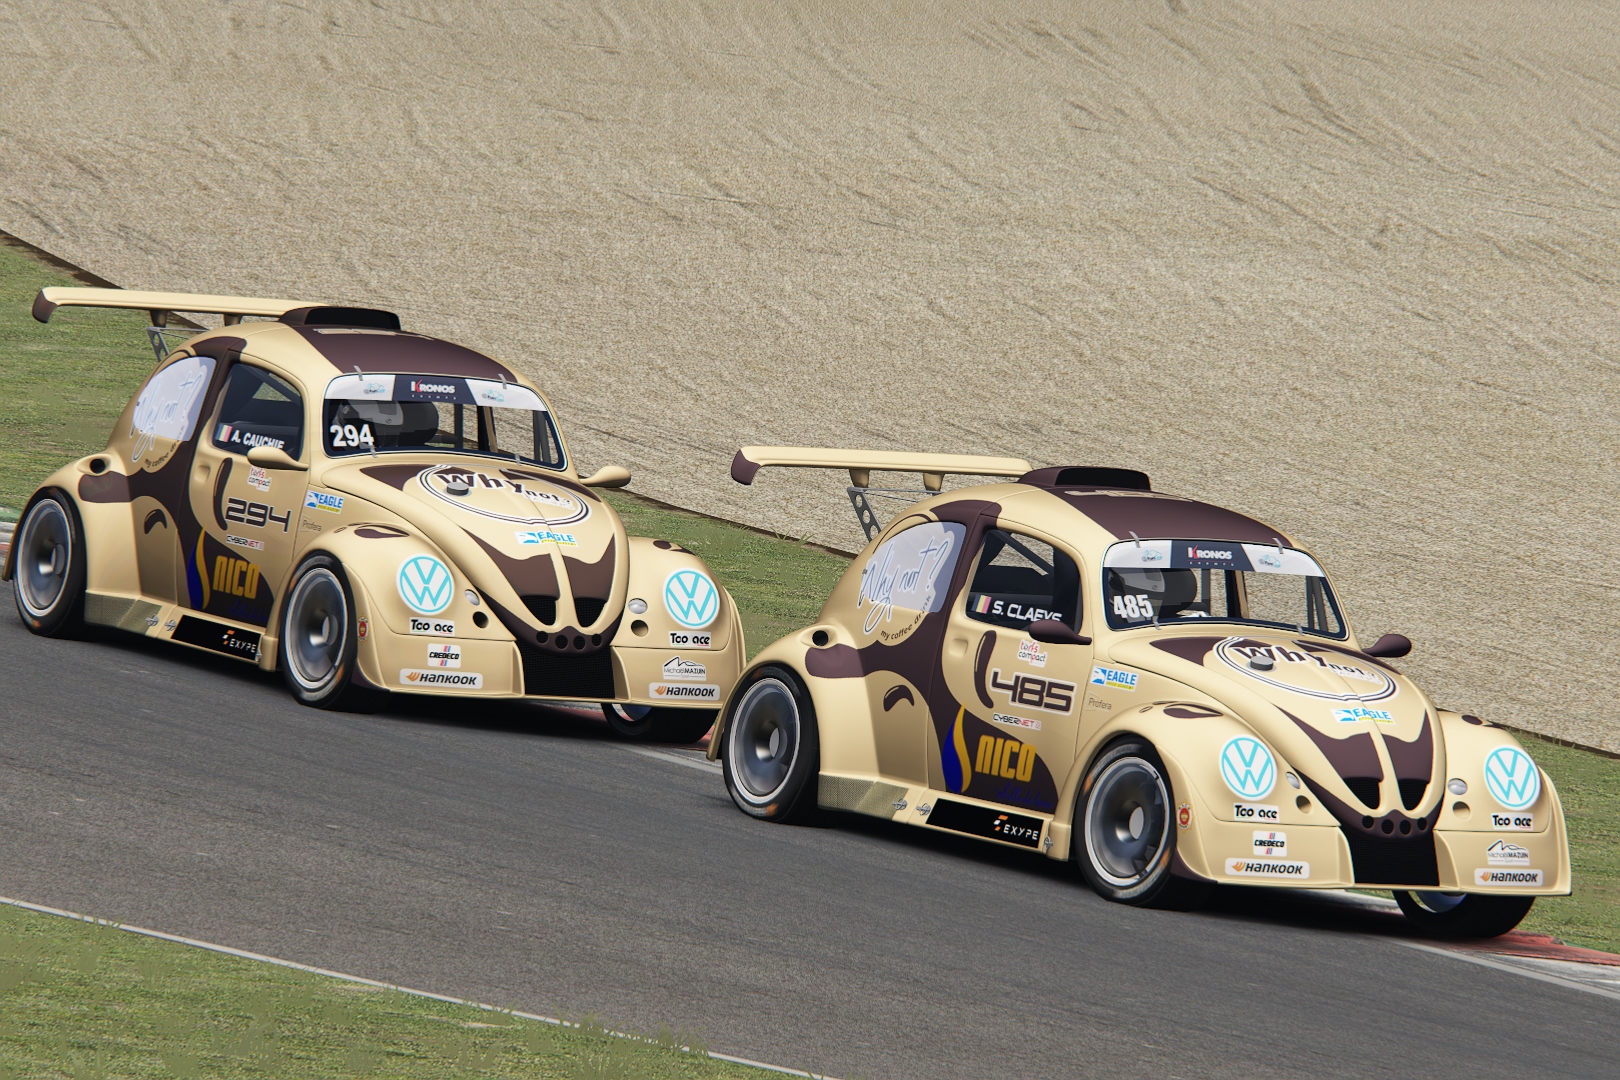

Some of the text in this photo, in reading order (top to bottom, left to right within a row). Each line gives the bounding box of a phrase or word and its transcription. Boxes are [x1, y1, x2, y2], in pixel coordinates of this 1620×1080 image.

[411, 379, 456, 394] KRONOS
[231, 430, 286, 450] A. CAUCHIE
[330, 424, 375, 447] 294
[318, 494, 344, 509] EAGLE
[225, 498, 292, 533] 294
[226, 536, 259, 549] CYBERNET
[537, 531, 576, 543] EAGLE
[1188, 546, 1232, 560] KRONOS
[212, 555, 261, 600] NICO
[992, 600, 1062, 622] S. CLAEYS
[1113, 594, 1154, 618] 485
[880, 630, 890, 641] my
[891, 624, 913, 640] coffee
[229, 639, 257, 652] EXYPE
[429, 652, 460, 660] CREDECO
[1018, 651, 1046, 663] compact
[1106, 669, 1137, 686] EAGLE
[991, 671, 1075, 712] 485
[1089, 697, 1112, 710] Profera
[993, 713, 1034, 727] CYBERNET
[1352, 708, 1391, 720] EAGLE
[975, 734, 1037, 783] NICO
[1003, 824, 1039, 841] EXYPE
[1254, 839, 1285, 848] CREDECO
